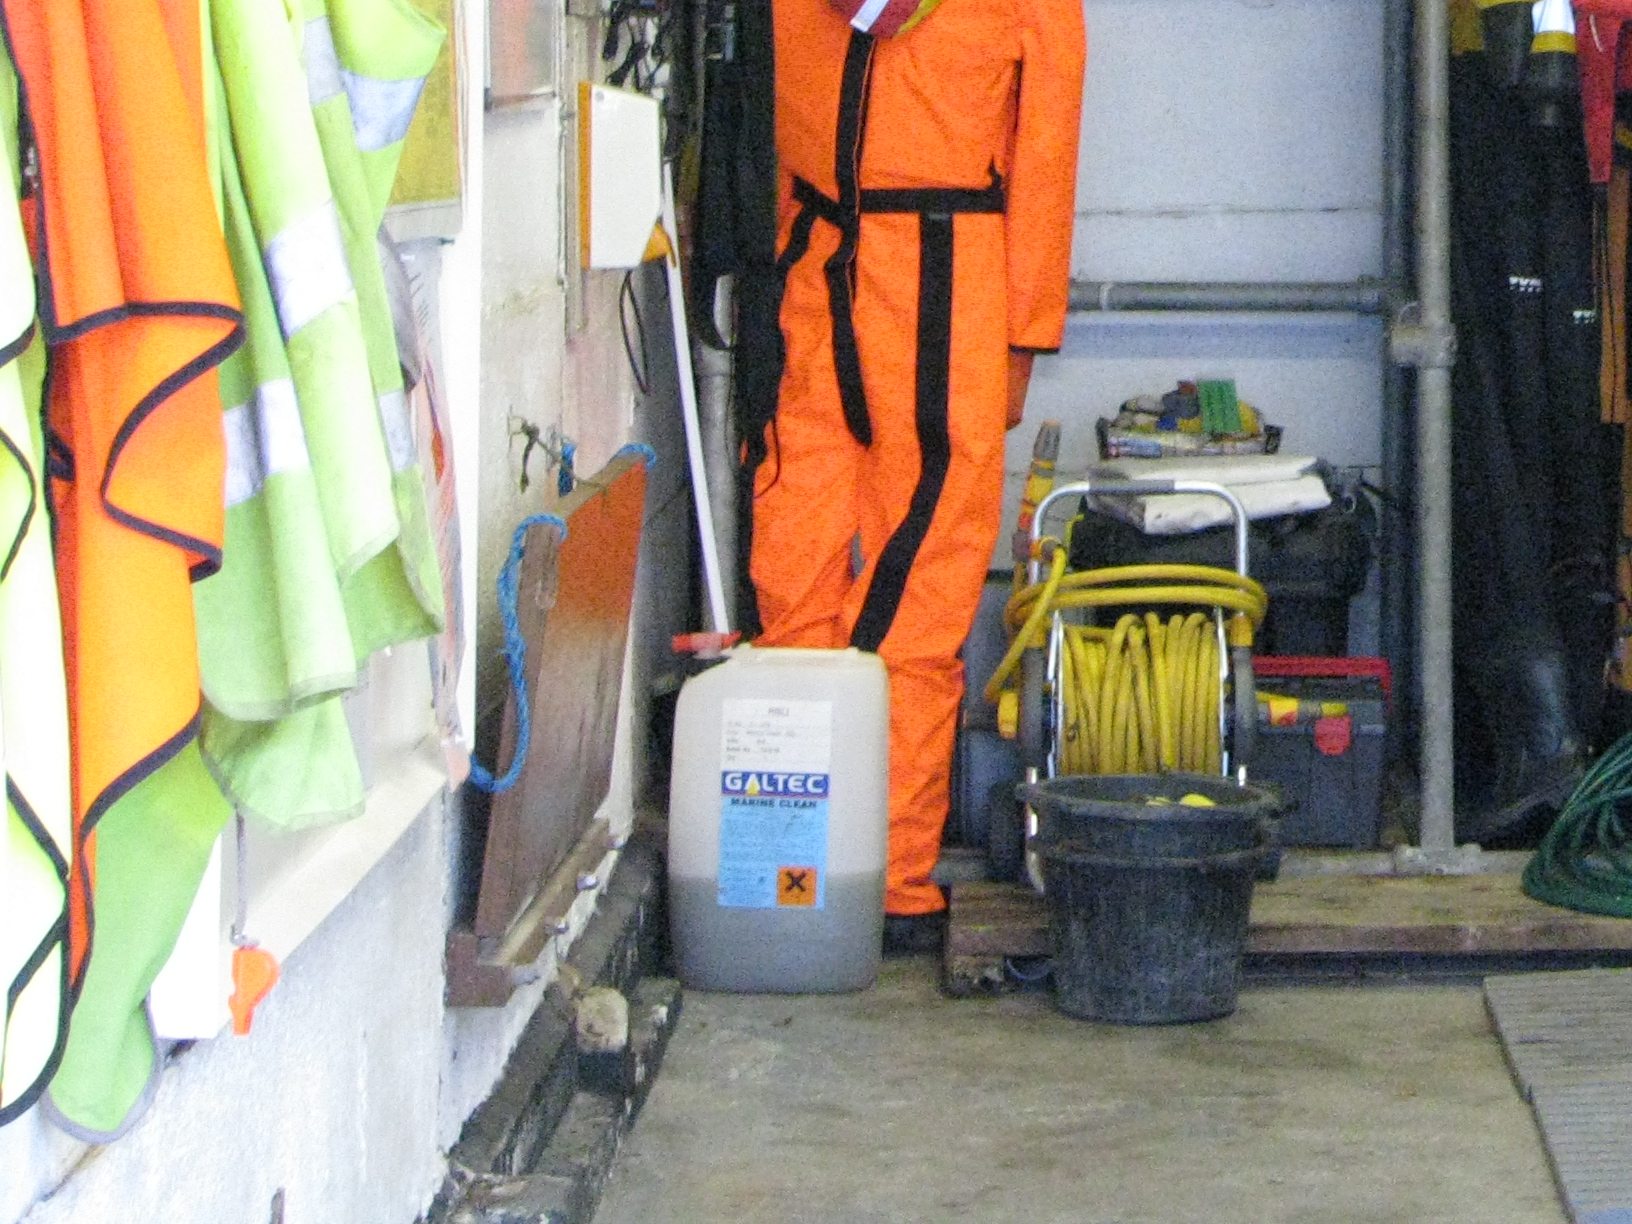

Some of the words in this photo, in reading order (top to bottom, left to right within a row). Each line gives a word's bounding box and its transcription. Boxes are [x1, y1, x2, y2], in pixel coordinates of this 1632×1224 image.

[725, 772, 824, 795] GALTEC
[730, 796, 775, 808] MARINE
[779, 798, 818, 809] CLEAN
